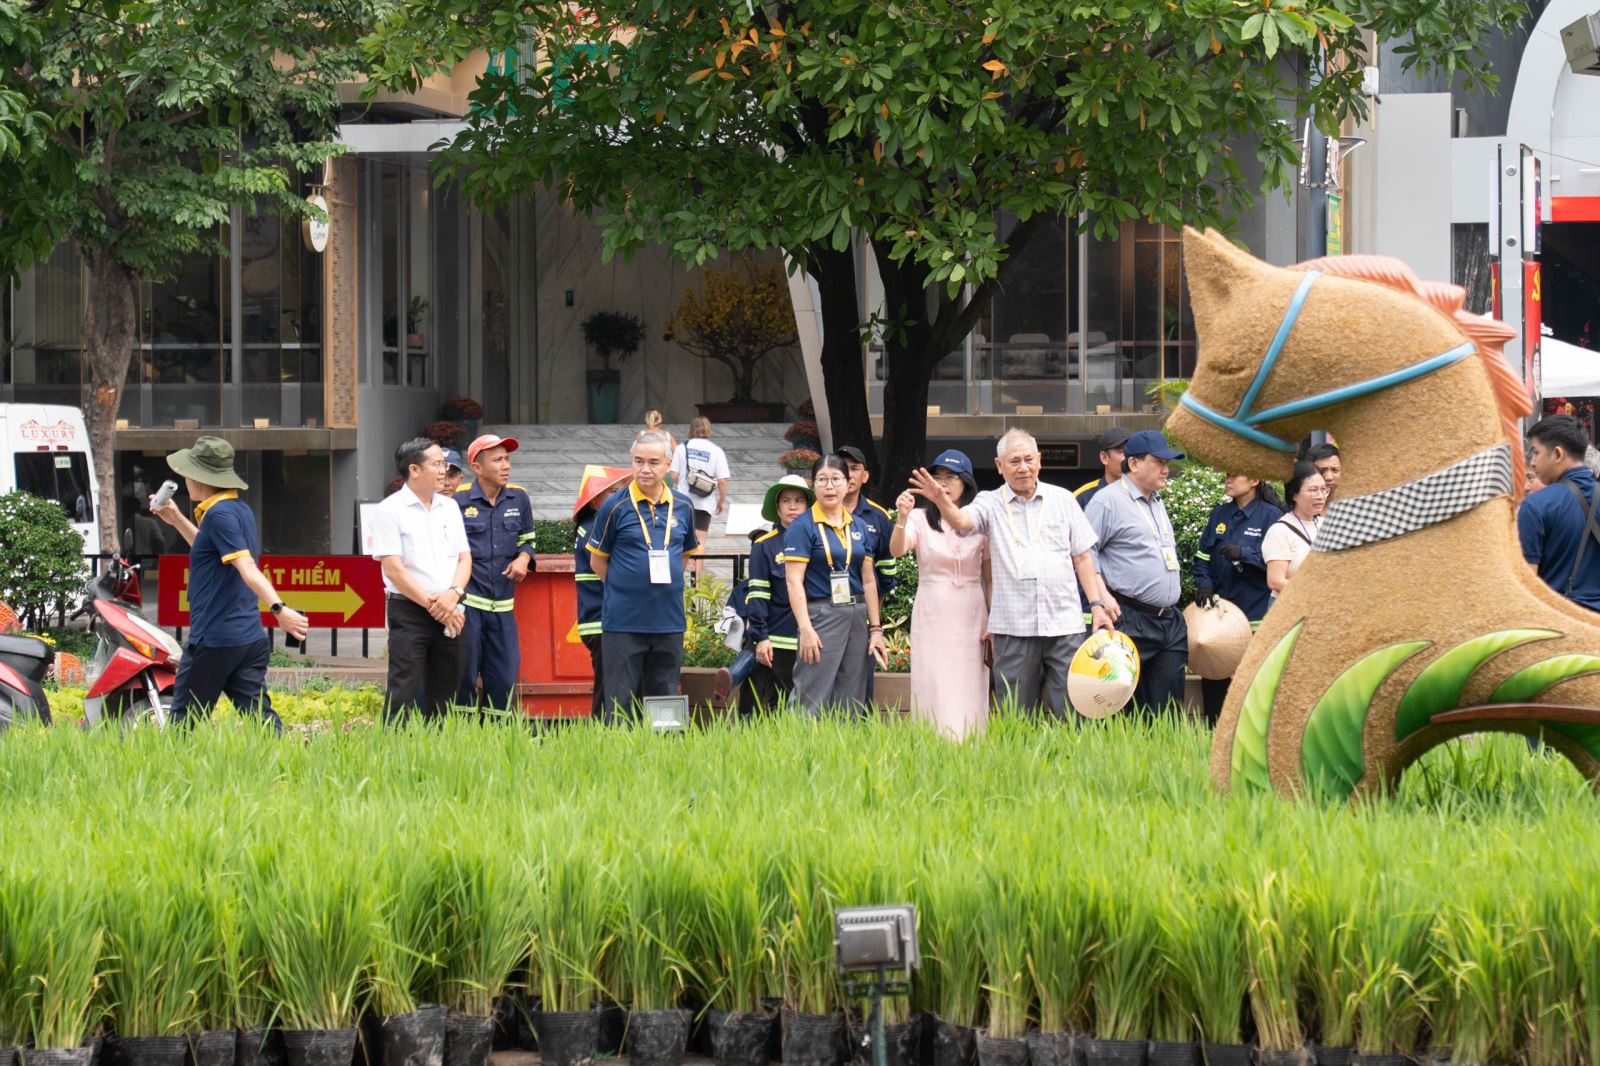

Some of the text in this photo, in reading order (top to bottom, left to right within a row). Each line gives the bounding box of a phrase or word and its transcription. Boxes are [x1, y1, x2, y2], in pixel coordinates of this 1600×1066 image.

[21, 429, 75, 439] LUXURY
[262, 560, 341, 586] ÁT HIỂM
